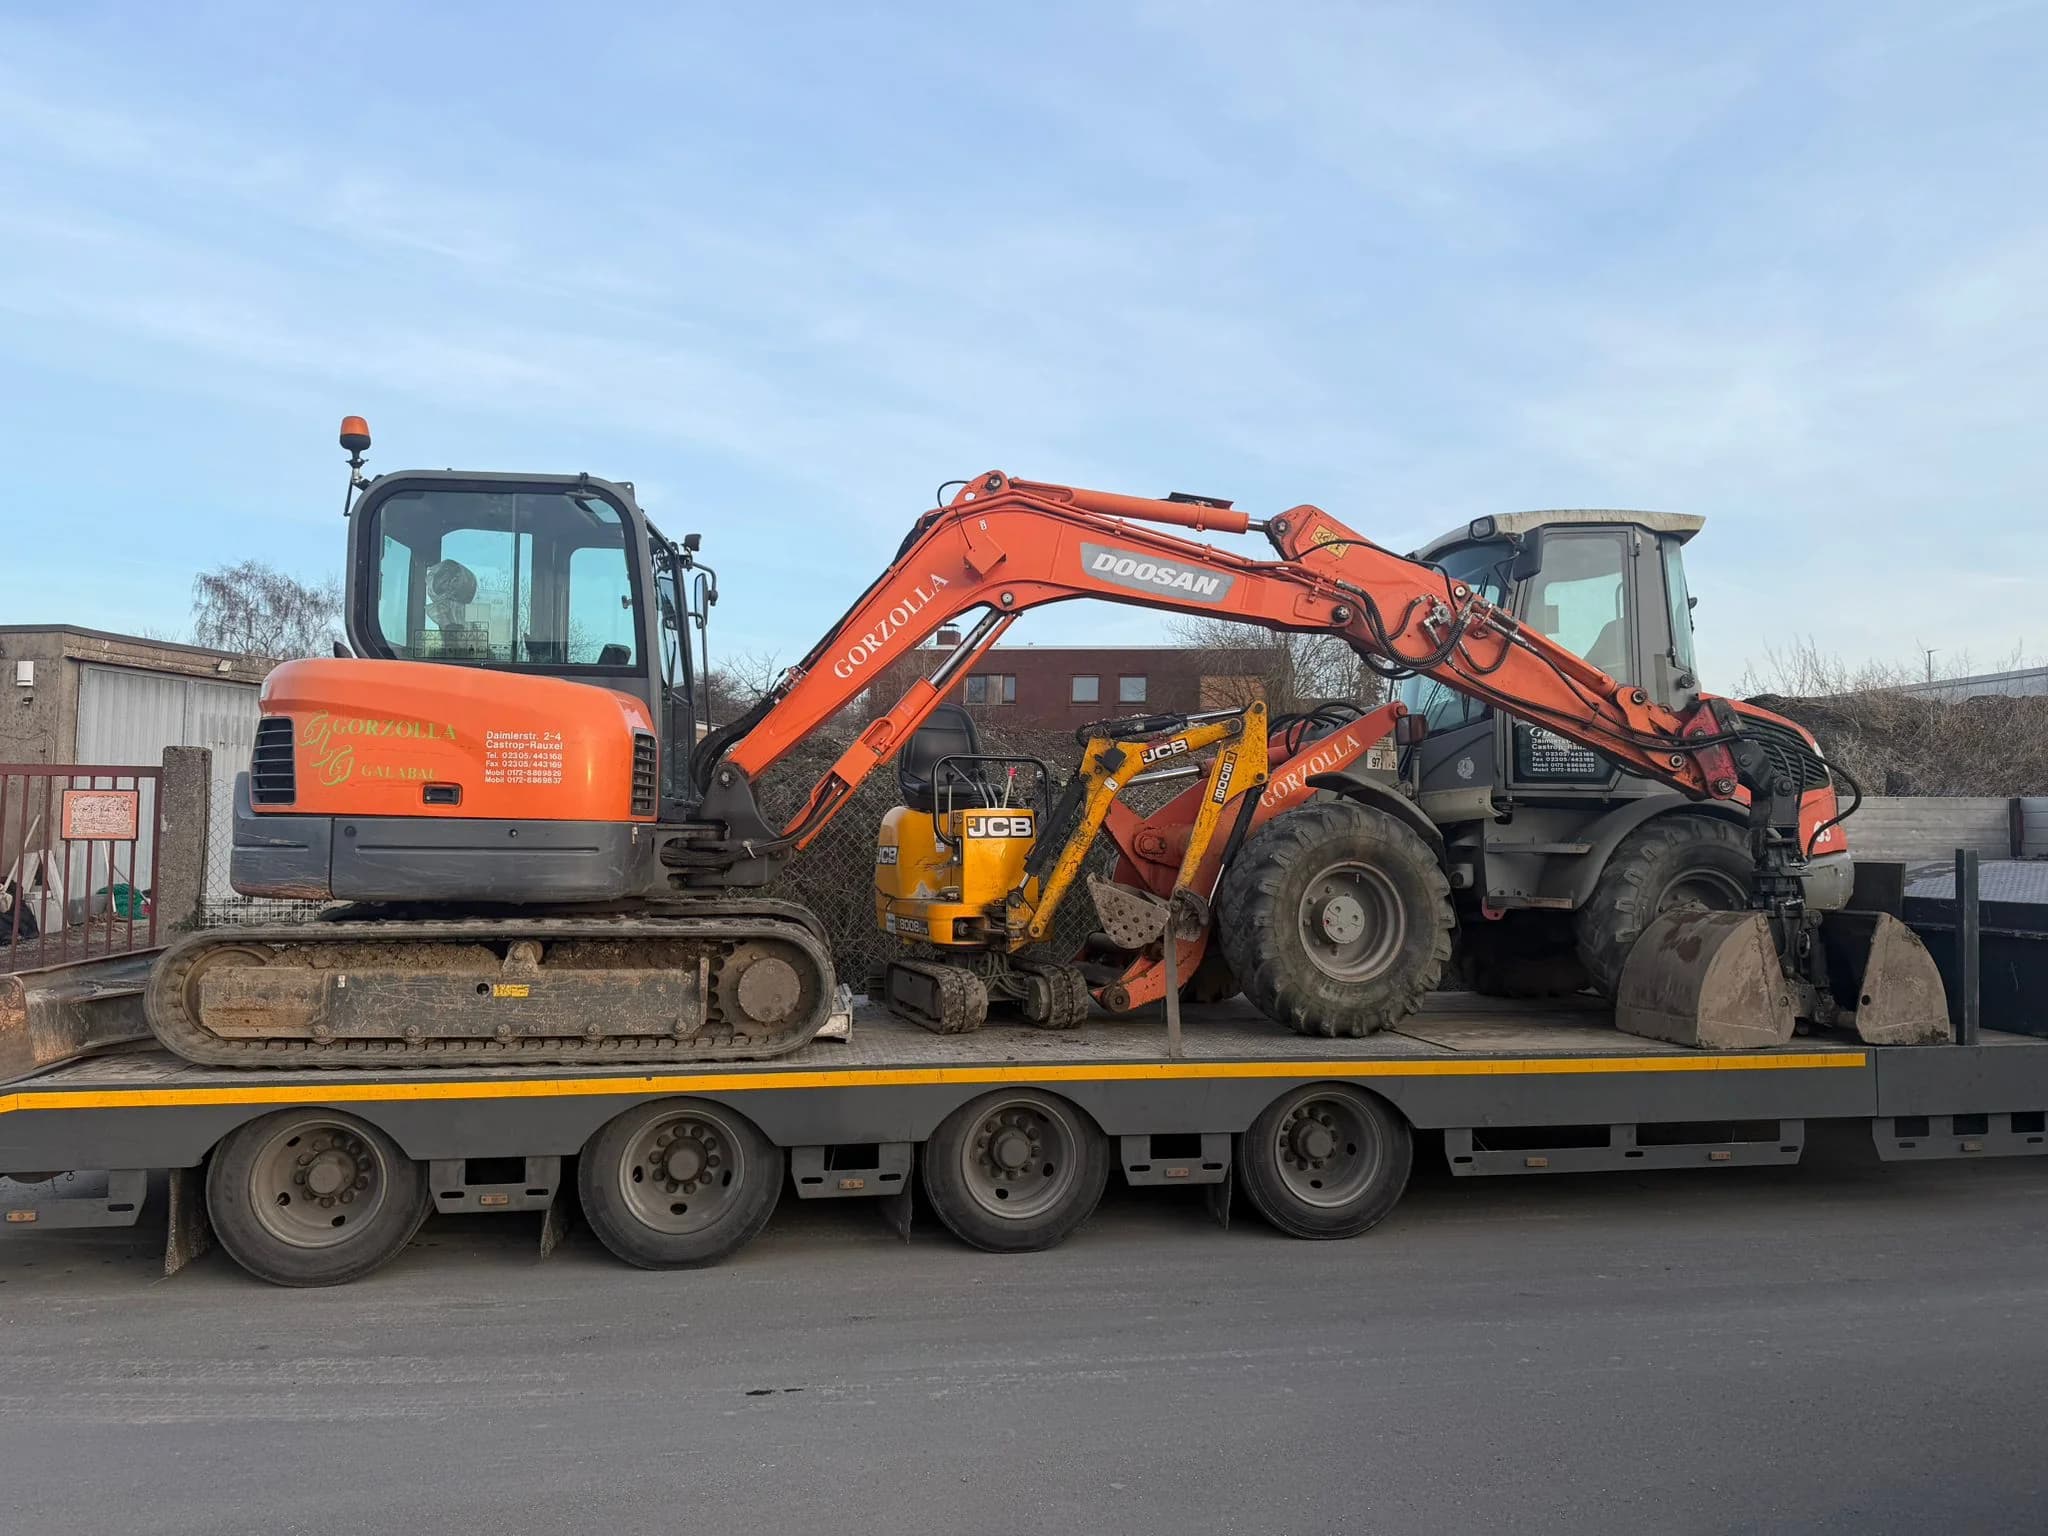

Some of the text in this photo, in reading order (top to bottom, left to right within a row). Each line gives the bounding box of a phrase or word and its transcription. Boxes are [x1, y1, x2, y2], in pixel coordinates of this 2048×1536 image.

[1092, 553, 1219, 595] DOOSAN
[833, 573, 949, 678] GORZOLLA
[332, 718, 457, 740] GORZOLLA
[486, 730, 561, 741] Daimlerstr. 2-4
[485, 740, 563, 750] Castrop-Rauxel
[1142, 739, 1188, 763] JCB
[1260, 734, 1360, 808] GORZOLLA
[968, 817, 1032, 837] JCB
[877, 847, 898, 864] JCB
